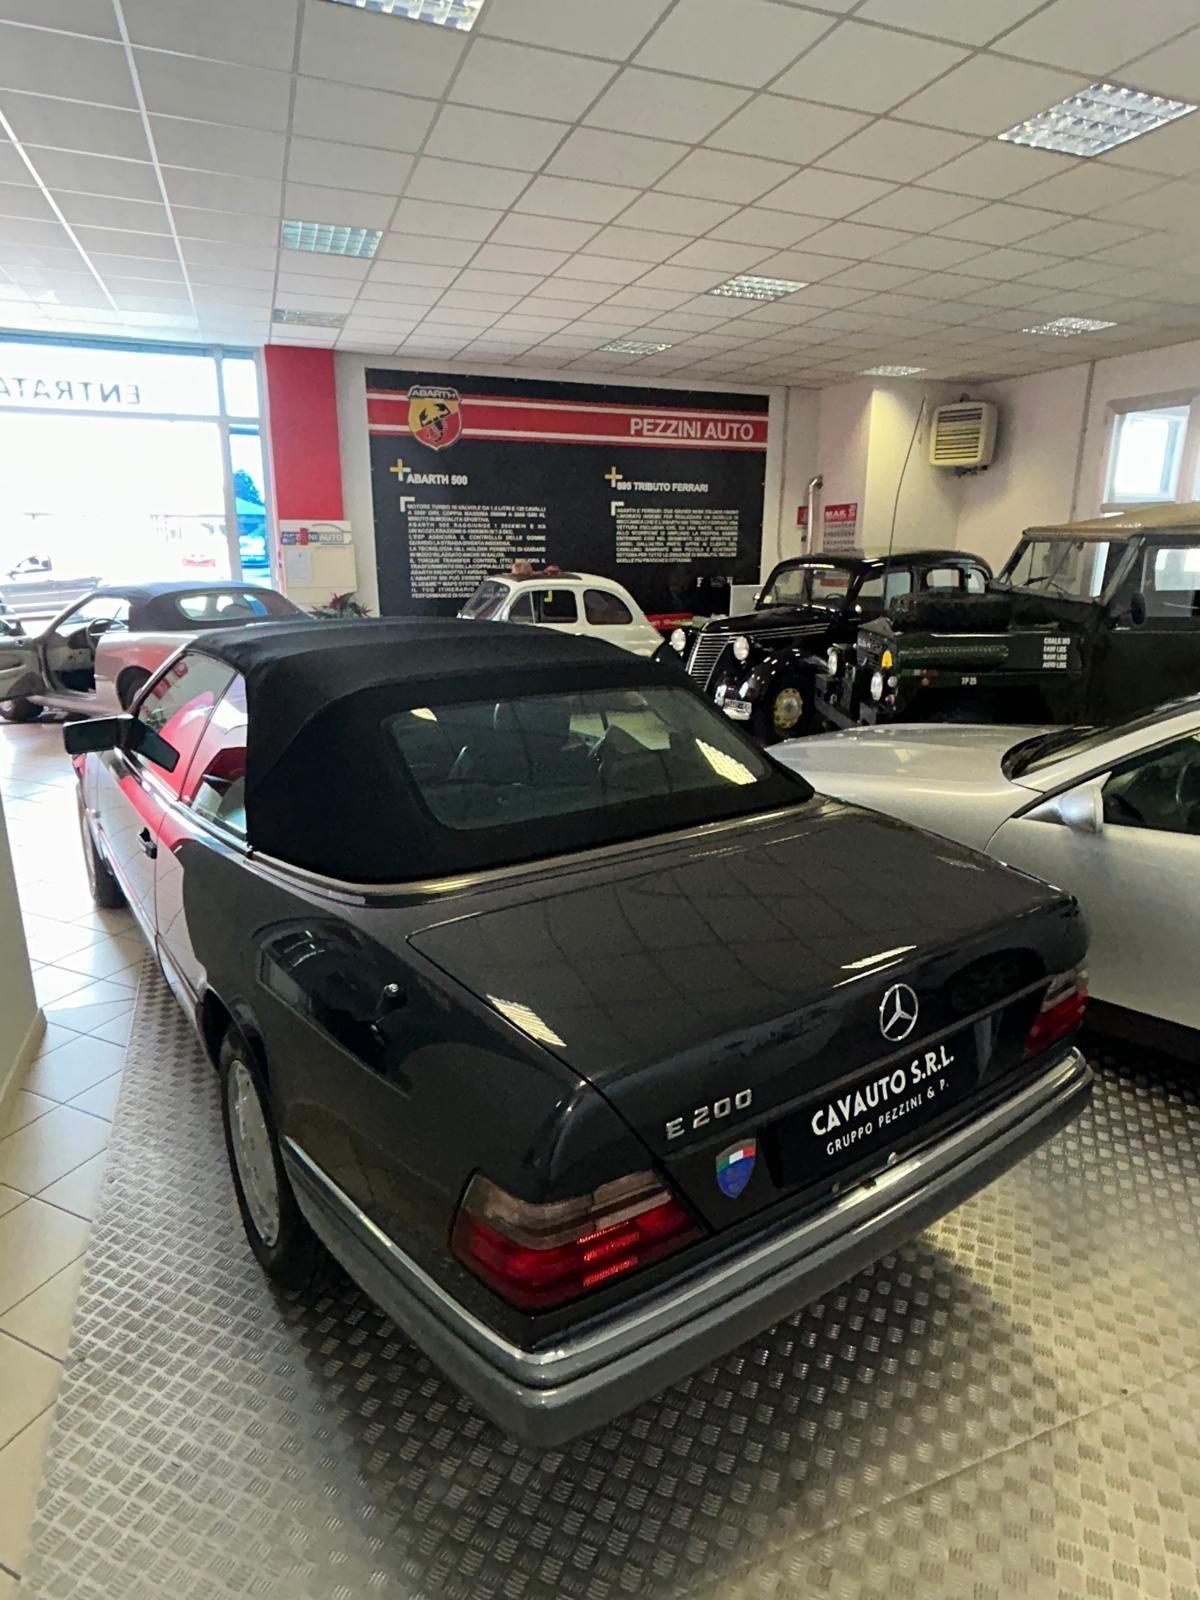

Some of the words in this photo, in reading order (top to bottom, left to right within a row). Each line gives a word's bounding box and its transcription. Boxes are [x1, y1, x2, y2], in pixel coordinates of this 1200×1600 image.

[412, 389, 456, 399] ABARTH
[630, 417, 701, 438] PEZZINI
[704, 422, 754, 440] AUTO
[406, 474, 449, 485] ABARTH
[451, 475, 468, 486] 500
[633, 482, 671, 491] TRIBUTO
[672, 483, 709, 492] FERRARI
[811, 1069, 906, 1136] CAVAUTO
[910, 1045, 955, 1084] S.R.L.
[666, 1117, 685, 1140] E
[693, 1088, 752, 1129] 200
[826, 1122, 873, 1156] GRUPPO
[878, 1093, 922, 1127] PEZZINI
[926, 1086, 935, 1099] &
[939, 1078, 949, 1091] P.
